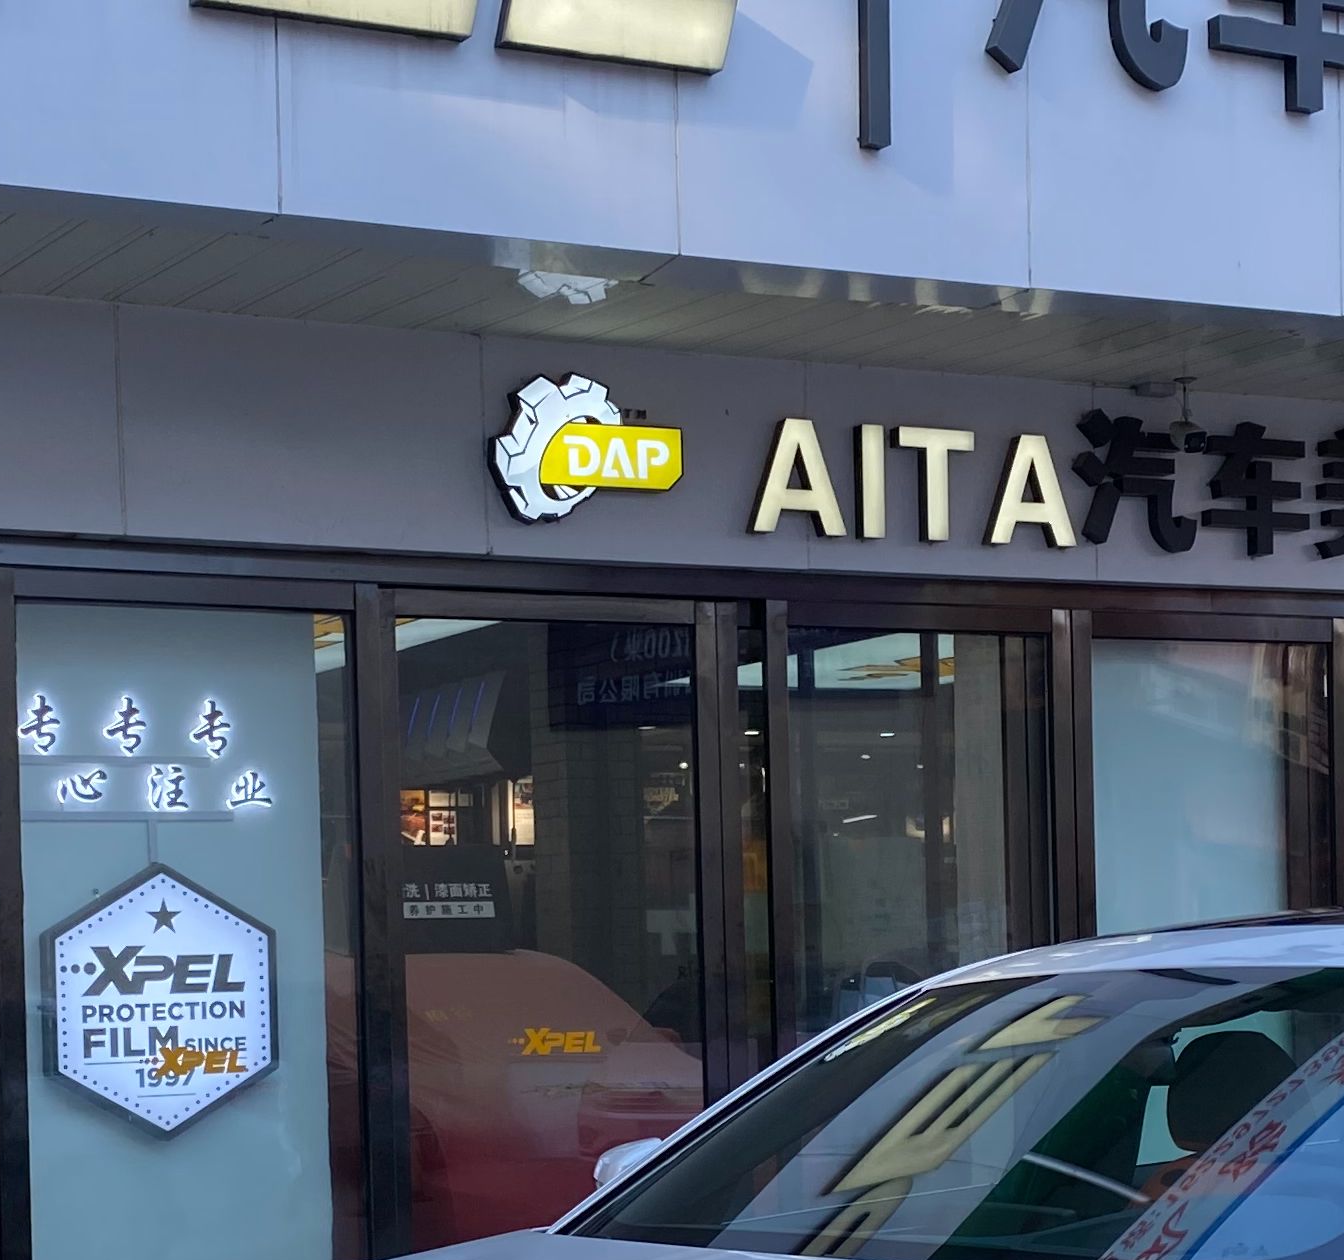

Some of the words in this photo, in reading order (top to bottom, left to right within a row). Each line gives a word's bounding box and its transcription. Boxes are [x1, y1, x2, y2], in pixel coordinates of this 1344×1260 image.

[563, 434, 670, 481] DAP
[81, 945, 247, 997] XPEL
[81, 999, 247, 1025] PROTECTION
[82, 1025, 179, 1059] FILM
[185, 1036, 247, 1052] SINCE
[521, 1027, 601, 1056] XPEL
